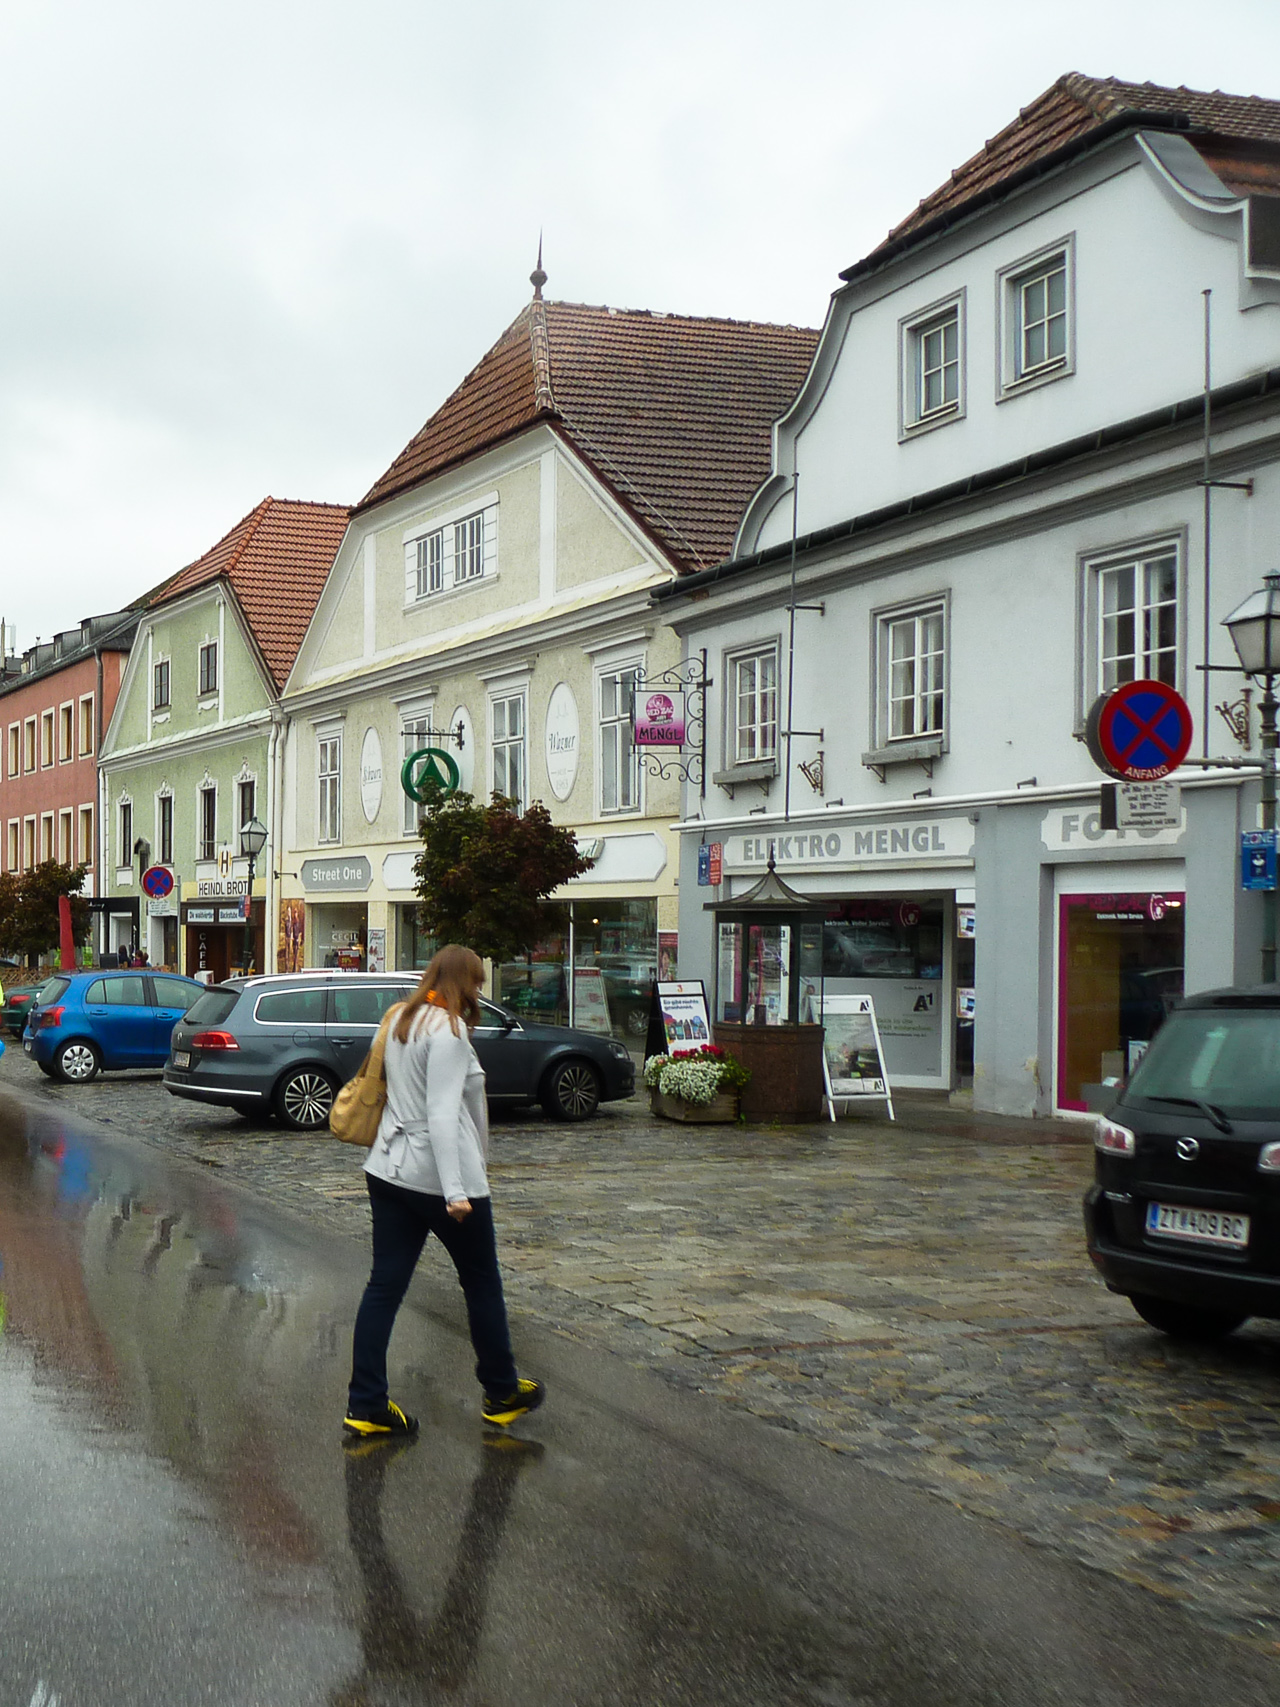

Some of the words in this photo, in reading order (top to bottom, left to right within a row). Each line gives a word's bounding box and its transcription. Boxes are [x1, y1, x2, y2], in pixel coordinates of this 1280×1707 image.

[638, 727, 682, 741] MENGL
[1124, 764, 1170, 779] ANFANG
[1061, 812, 1163, 842] FO
[743, 832, 841, 861] ELEKTRO
[854, 826, 945, 855] MENGL
[312, 868, 341, 882] Street
[342, 866, 362, 881] One
[198, 881, 225, 896] HEINDL
[226, 880, 249, 895] BROT
[860, 1000, 869, 1012] A1
[913, 992, 933, 1013] A1
[1160, 1207, 1179, 1230] ZT
[1189, 1211, 1218, 1236] 409
